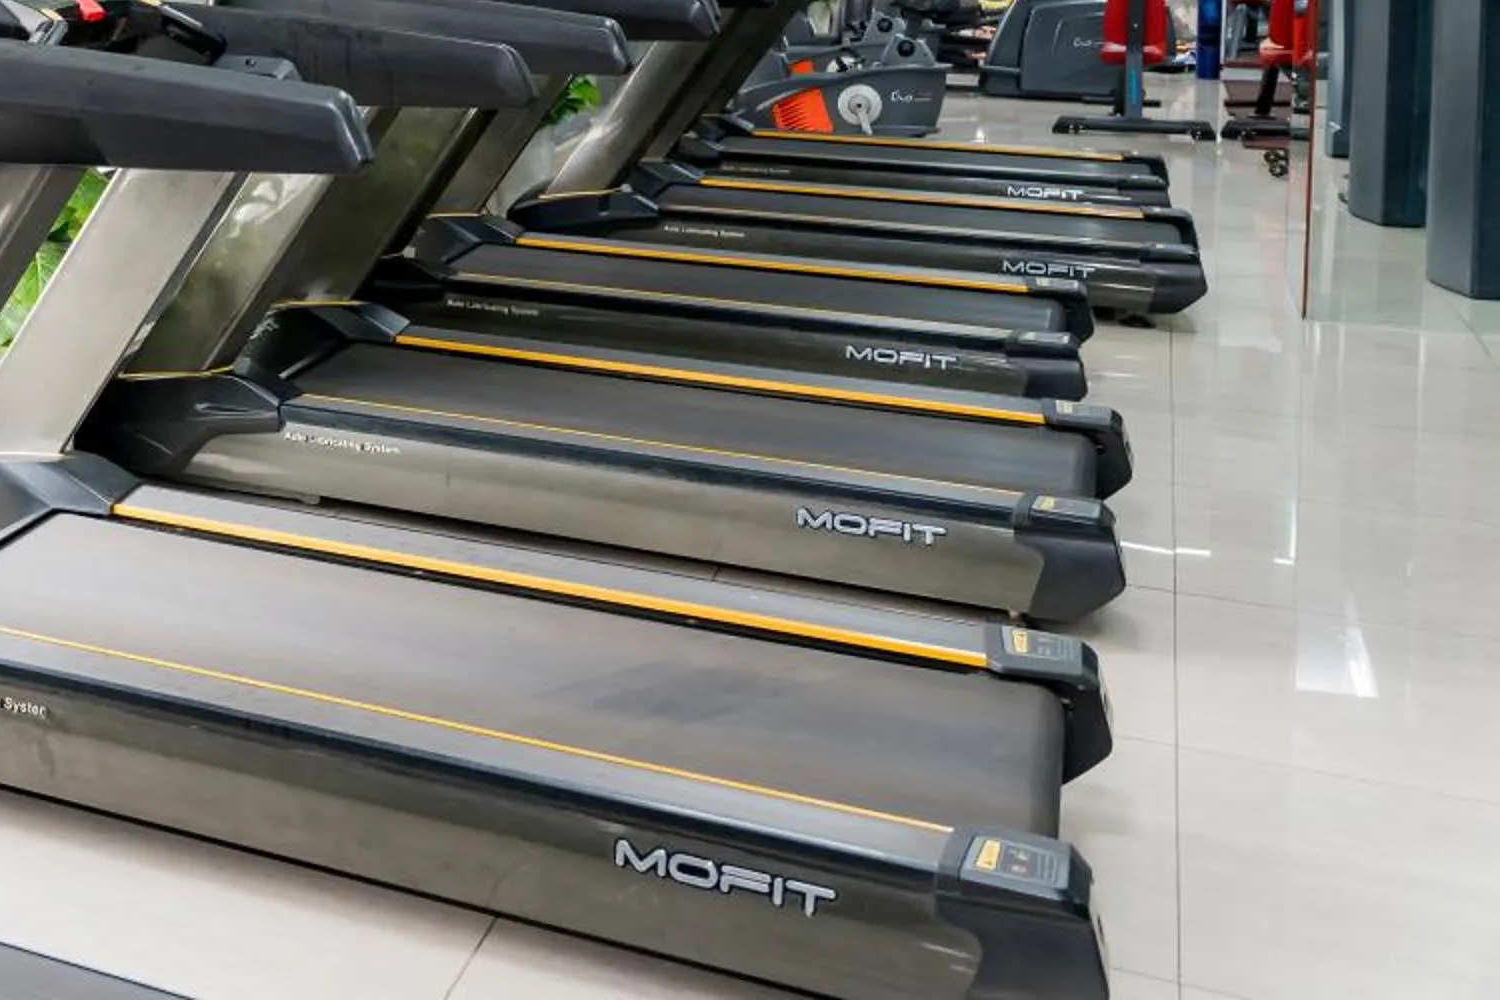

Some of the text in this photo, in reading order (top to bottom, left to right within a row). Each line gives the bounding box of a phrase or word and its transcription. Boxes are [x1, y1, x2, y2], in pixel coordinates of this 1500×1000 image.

[1007, 185, 1084, 200] MOFIT
[1003, 260, 1096, 278] MOFIT
[845, 345, 957, 370] MOFIT
[797, 507, 947, 546] MOFIT
[615, 839, 836, 918] MOFIT
